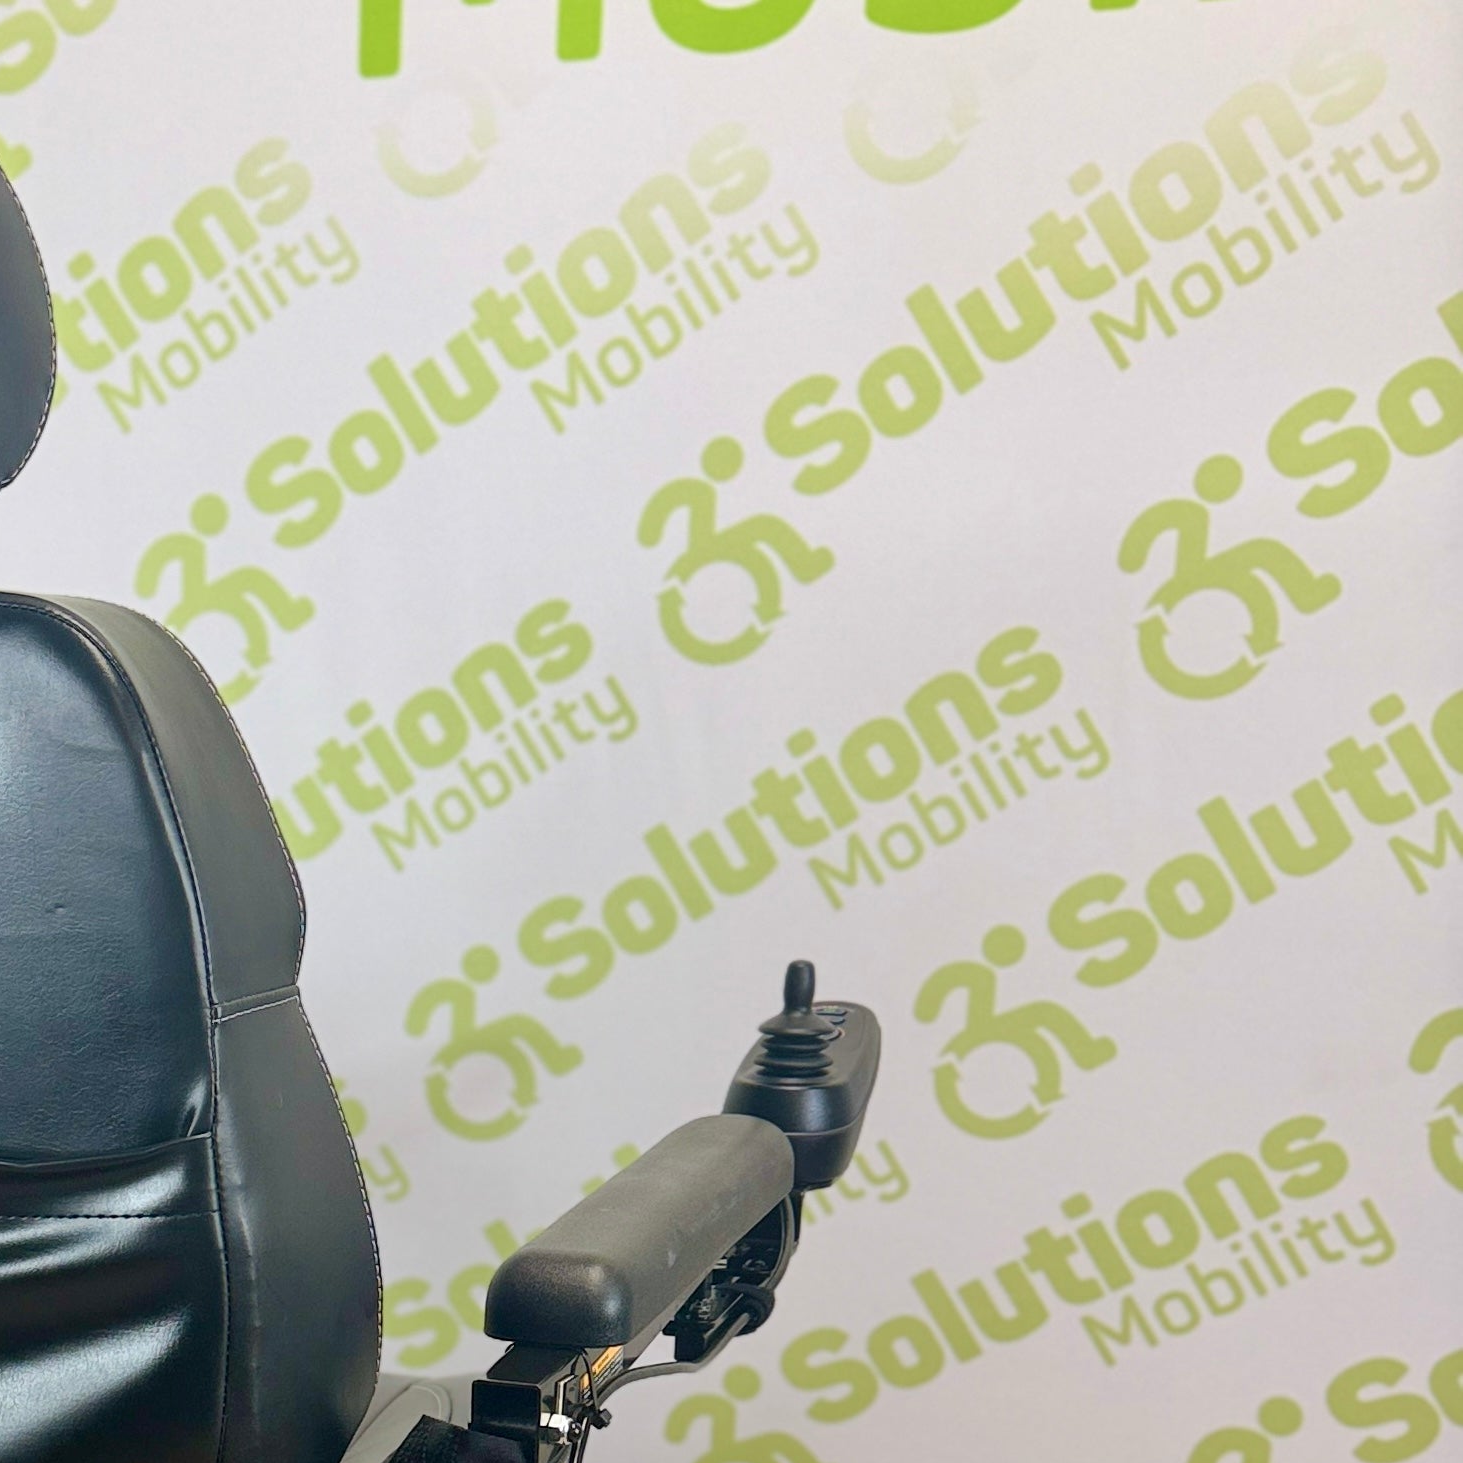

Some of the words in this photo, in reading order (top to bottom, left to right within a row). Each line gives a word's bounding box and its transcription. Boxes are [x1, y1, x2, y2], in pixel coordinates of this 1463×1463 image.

[95, 216, 361, 434] Mobility
[244, 121, 772, 549] Solutions
[529, 203, 821, 435] Mobility
[761, 26, 1390, 497] Solutions
[1089, 111, 1441, 371] Mobility
[371, 675, 639, 872] Mobility
[517, 625, 1064, 1001] Solutions
[808, 707, 1113, 910] Mobility
[778, 1114, 1350, 1424] Solutions
[1081, 1198, 1398, 1367] Mobility
